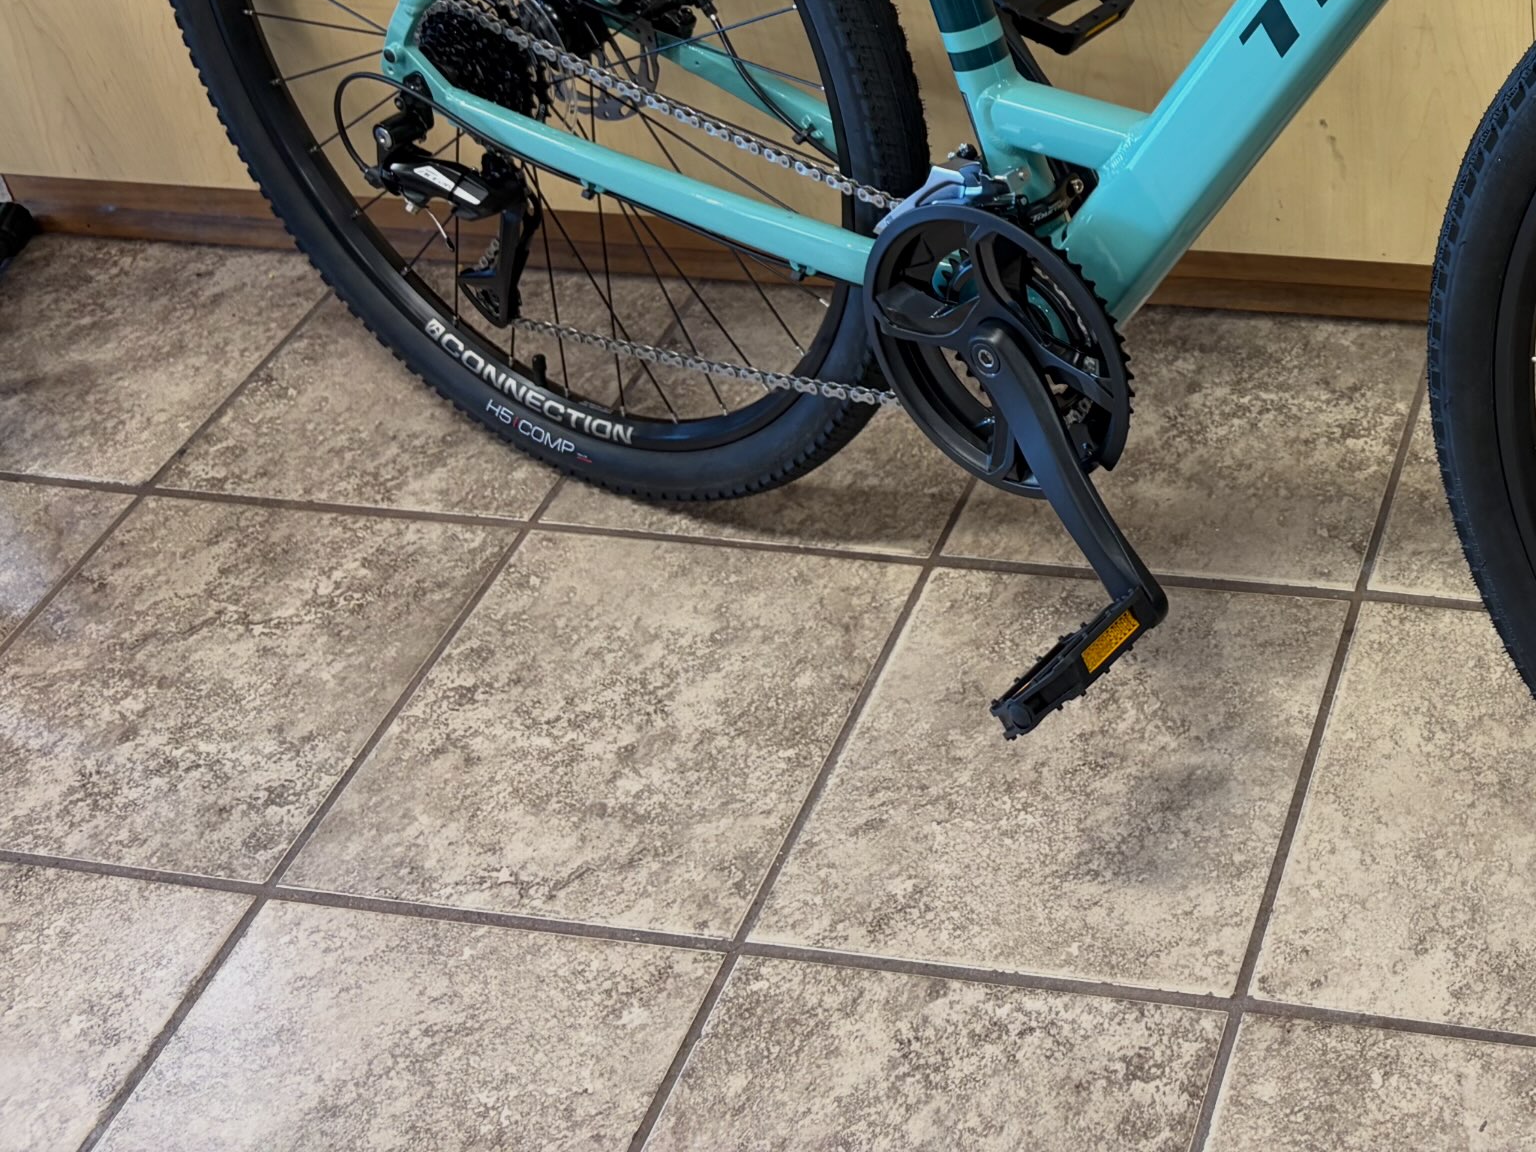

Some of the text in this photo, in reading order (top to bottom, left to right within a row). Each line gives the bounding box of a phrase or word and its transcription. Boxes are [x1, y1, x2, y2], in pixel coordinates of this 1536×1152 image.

[439, 332, 635, 445] CONNECTION
[486, 399, 576, 454] H5 COMP
